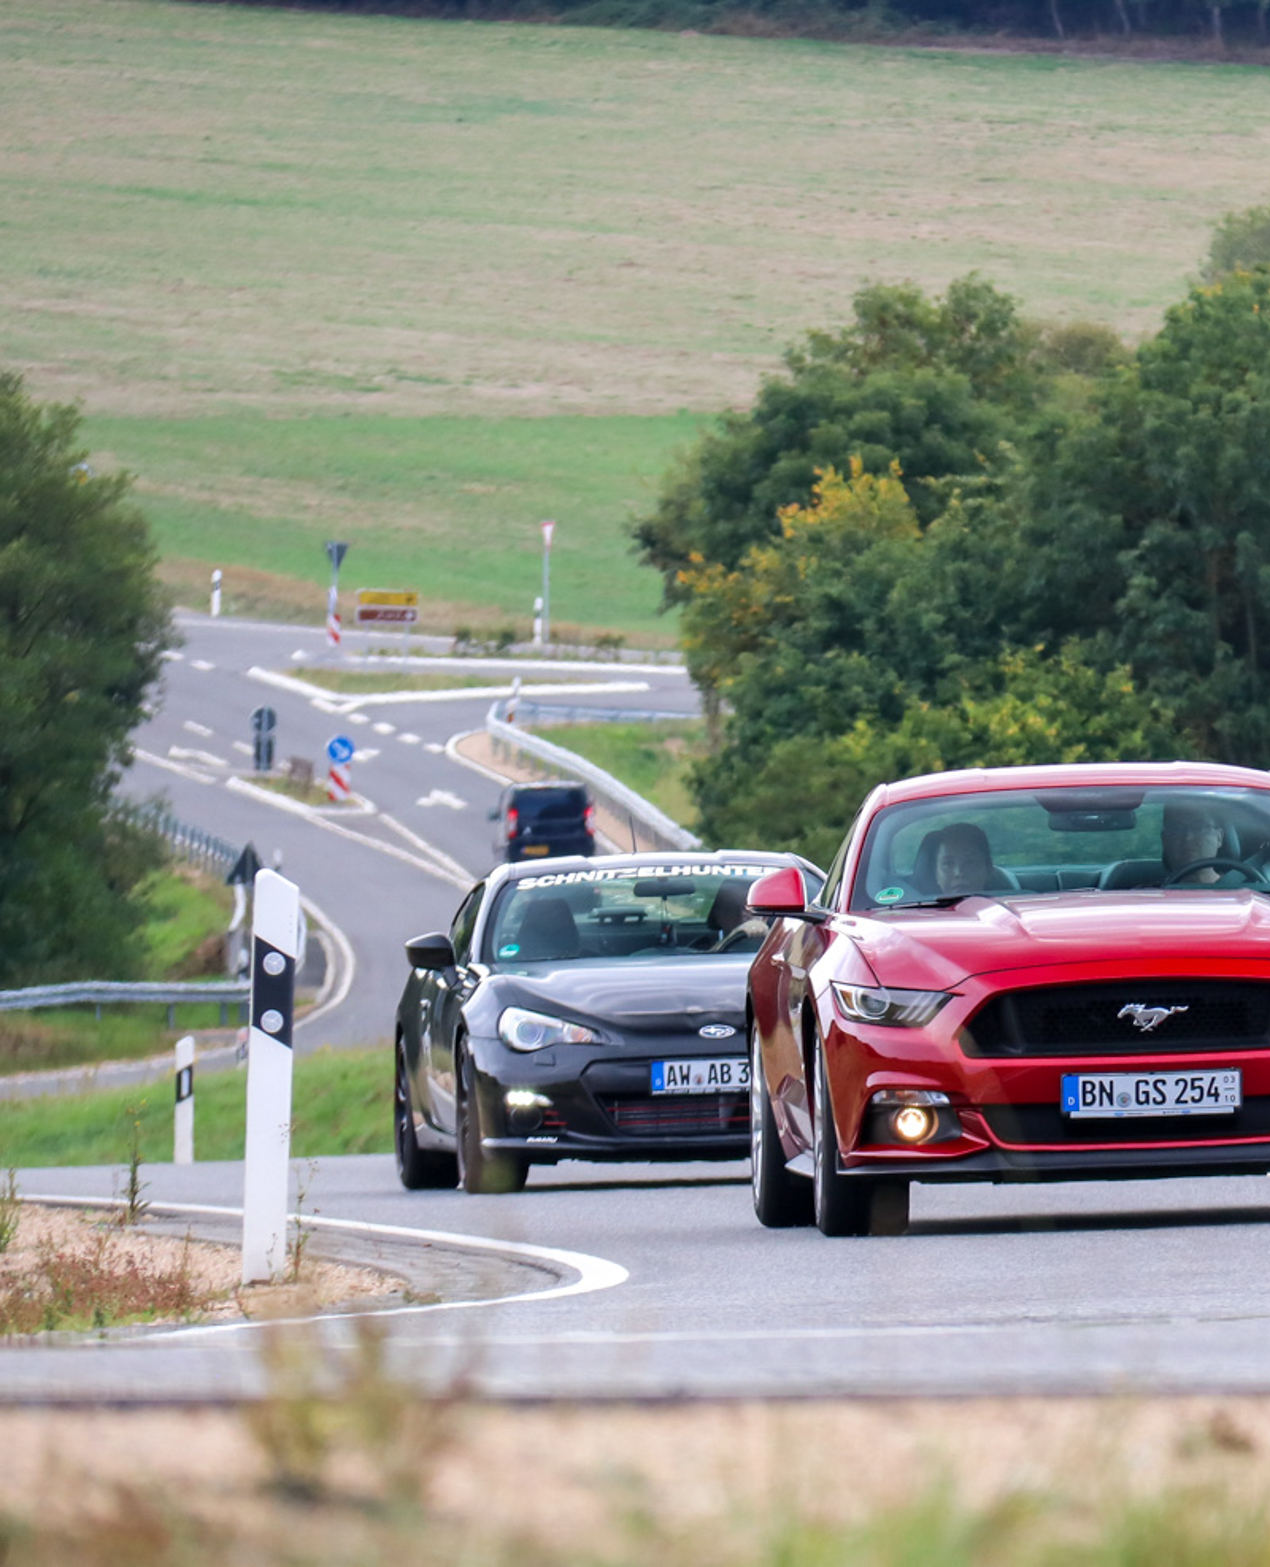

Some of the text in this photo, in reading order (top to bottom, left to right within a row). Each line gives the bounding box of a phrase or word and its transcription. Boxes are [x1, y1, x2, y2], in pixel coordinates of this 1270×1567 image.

[667, 1064, 690, 1086] AW
[708, 1063, 731, 1084] AB
[1081, 1077, 1220, 1107] BN GS 254
